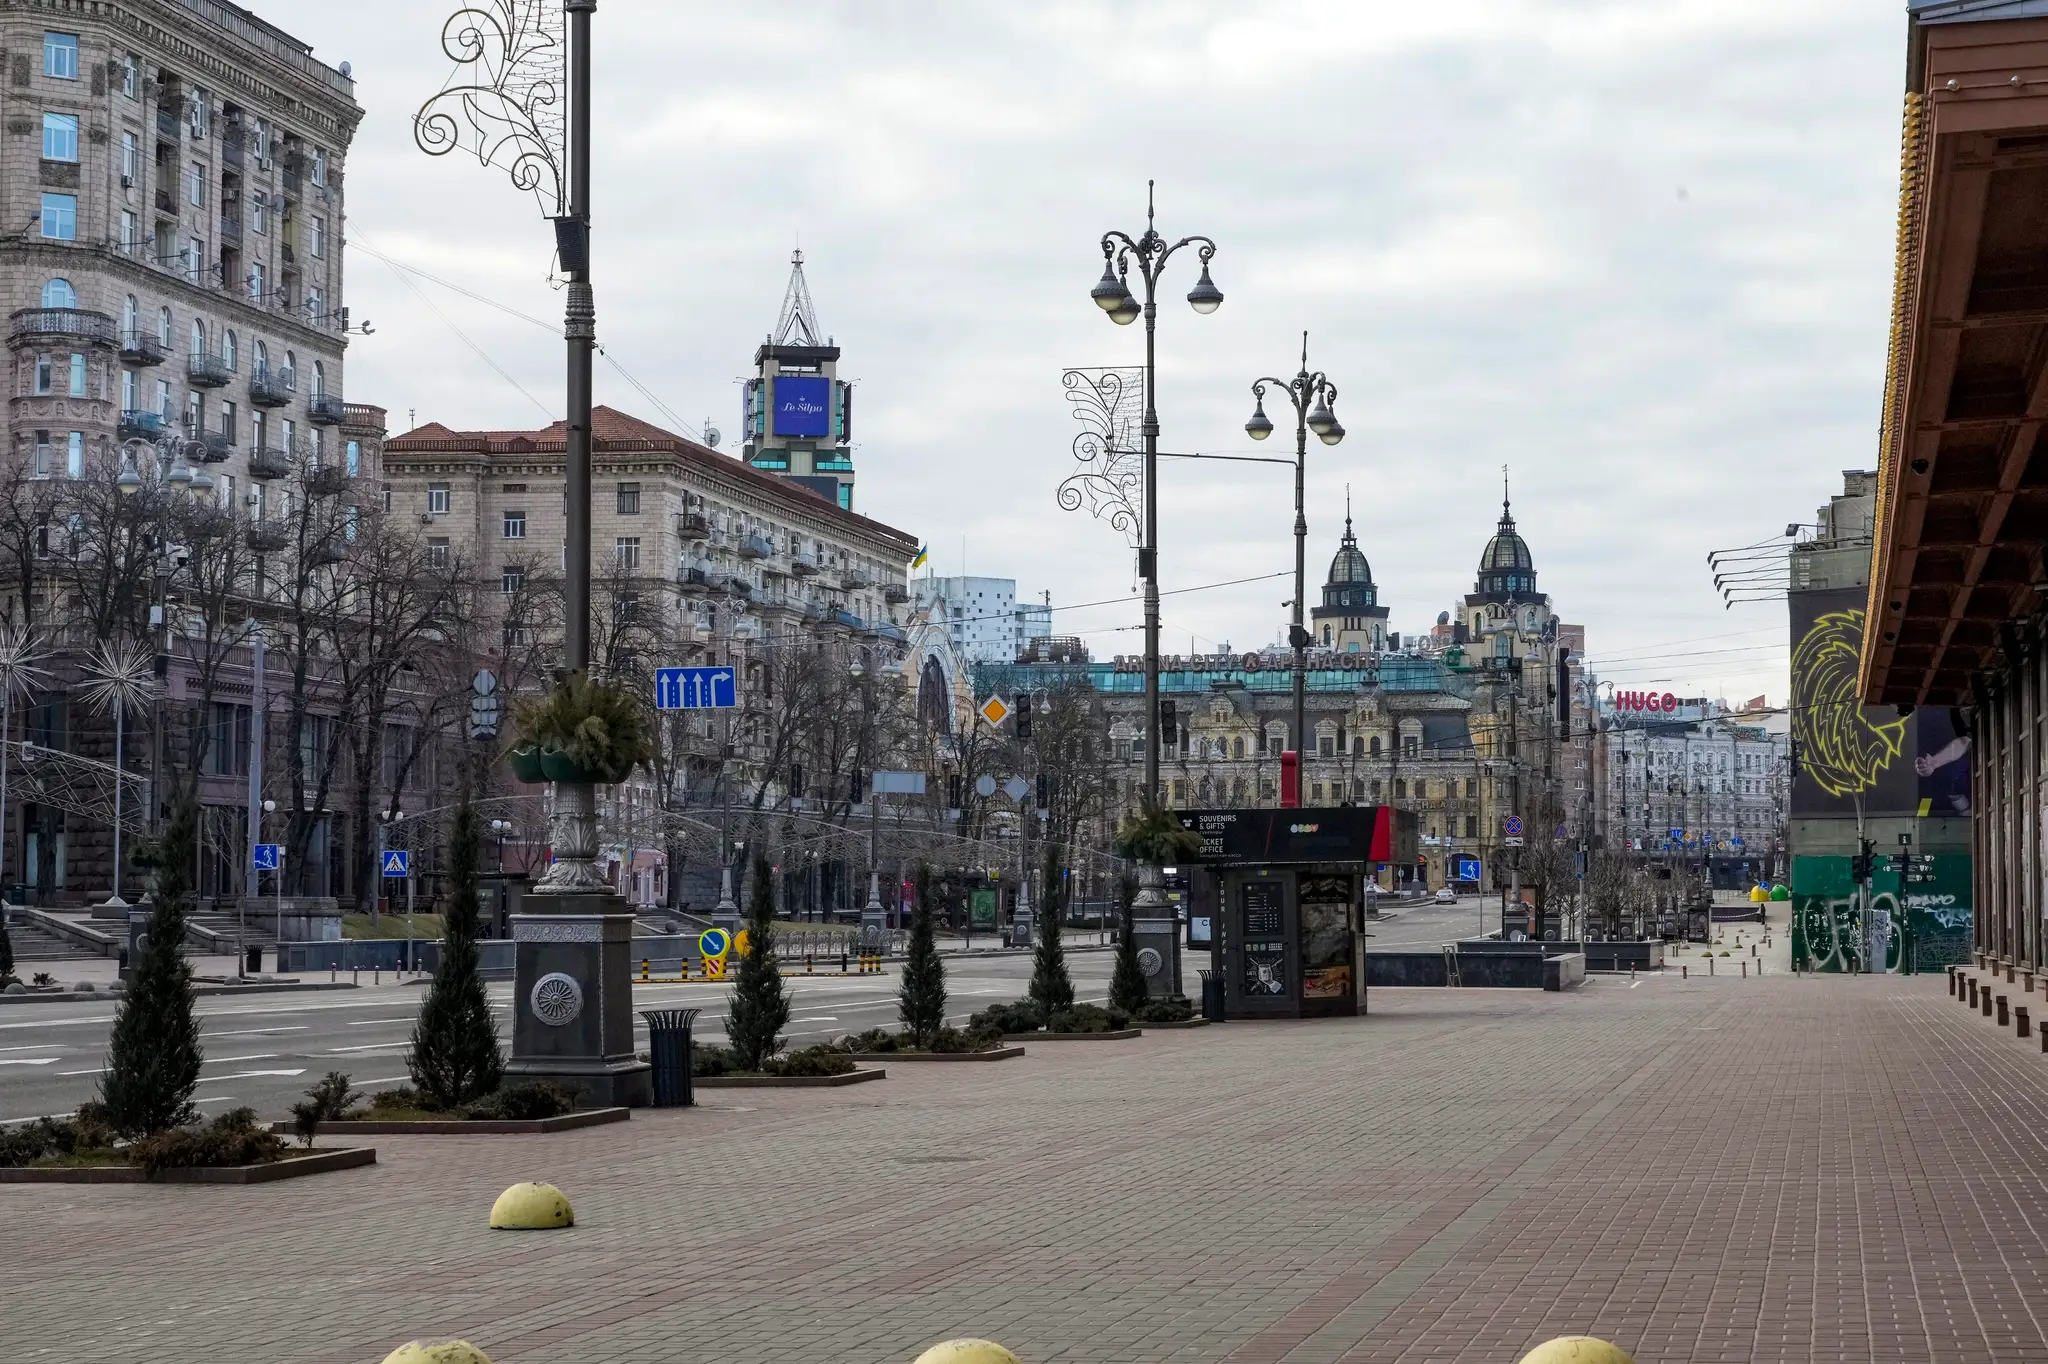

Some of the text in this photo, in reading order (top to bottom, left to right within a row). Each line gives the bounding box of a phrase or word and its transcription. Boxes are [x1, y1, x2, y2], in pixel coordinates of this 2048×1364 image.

[797, 402, 823, 415] Silpo
[1114, 654, 1235, 672] ARNA CITY
[1616, 690, 1677, 713] HUGO
[1199, 815, 1237, 823] SOUVENIRS
[1206, 822, 1225, 830] GIFTS
[1199, 846, 1224, 854] OFFICE
